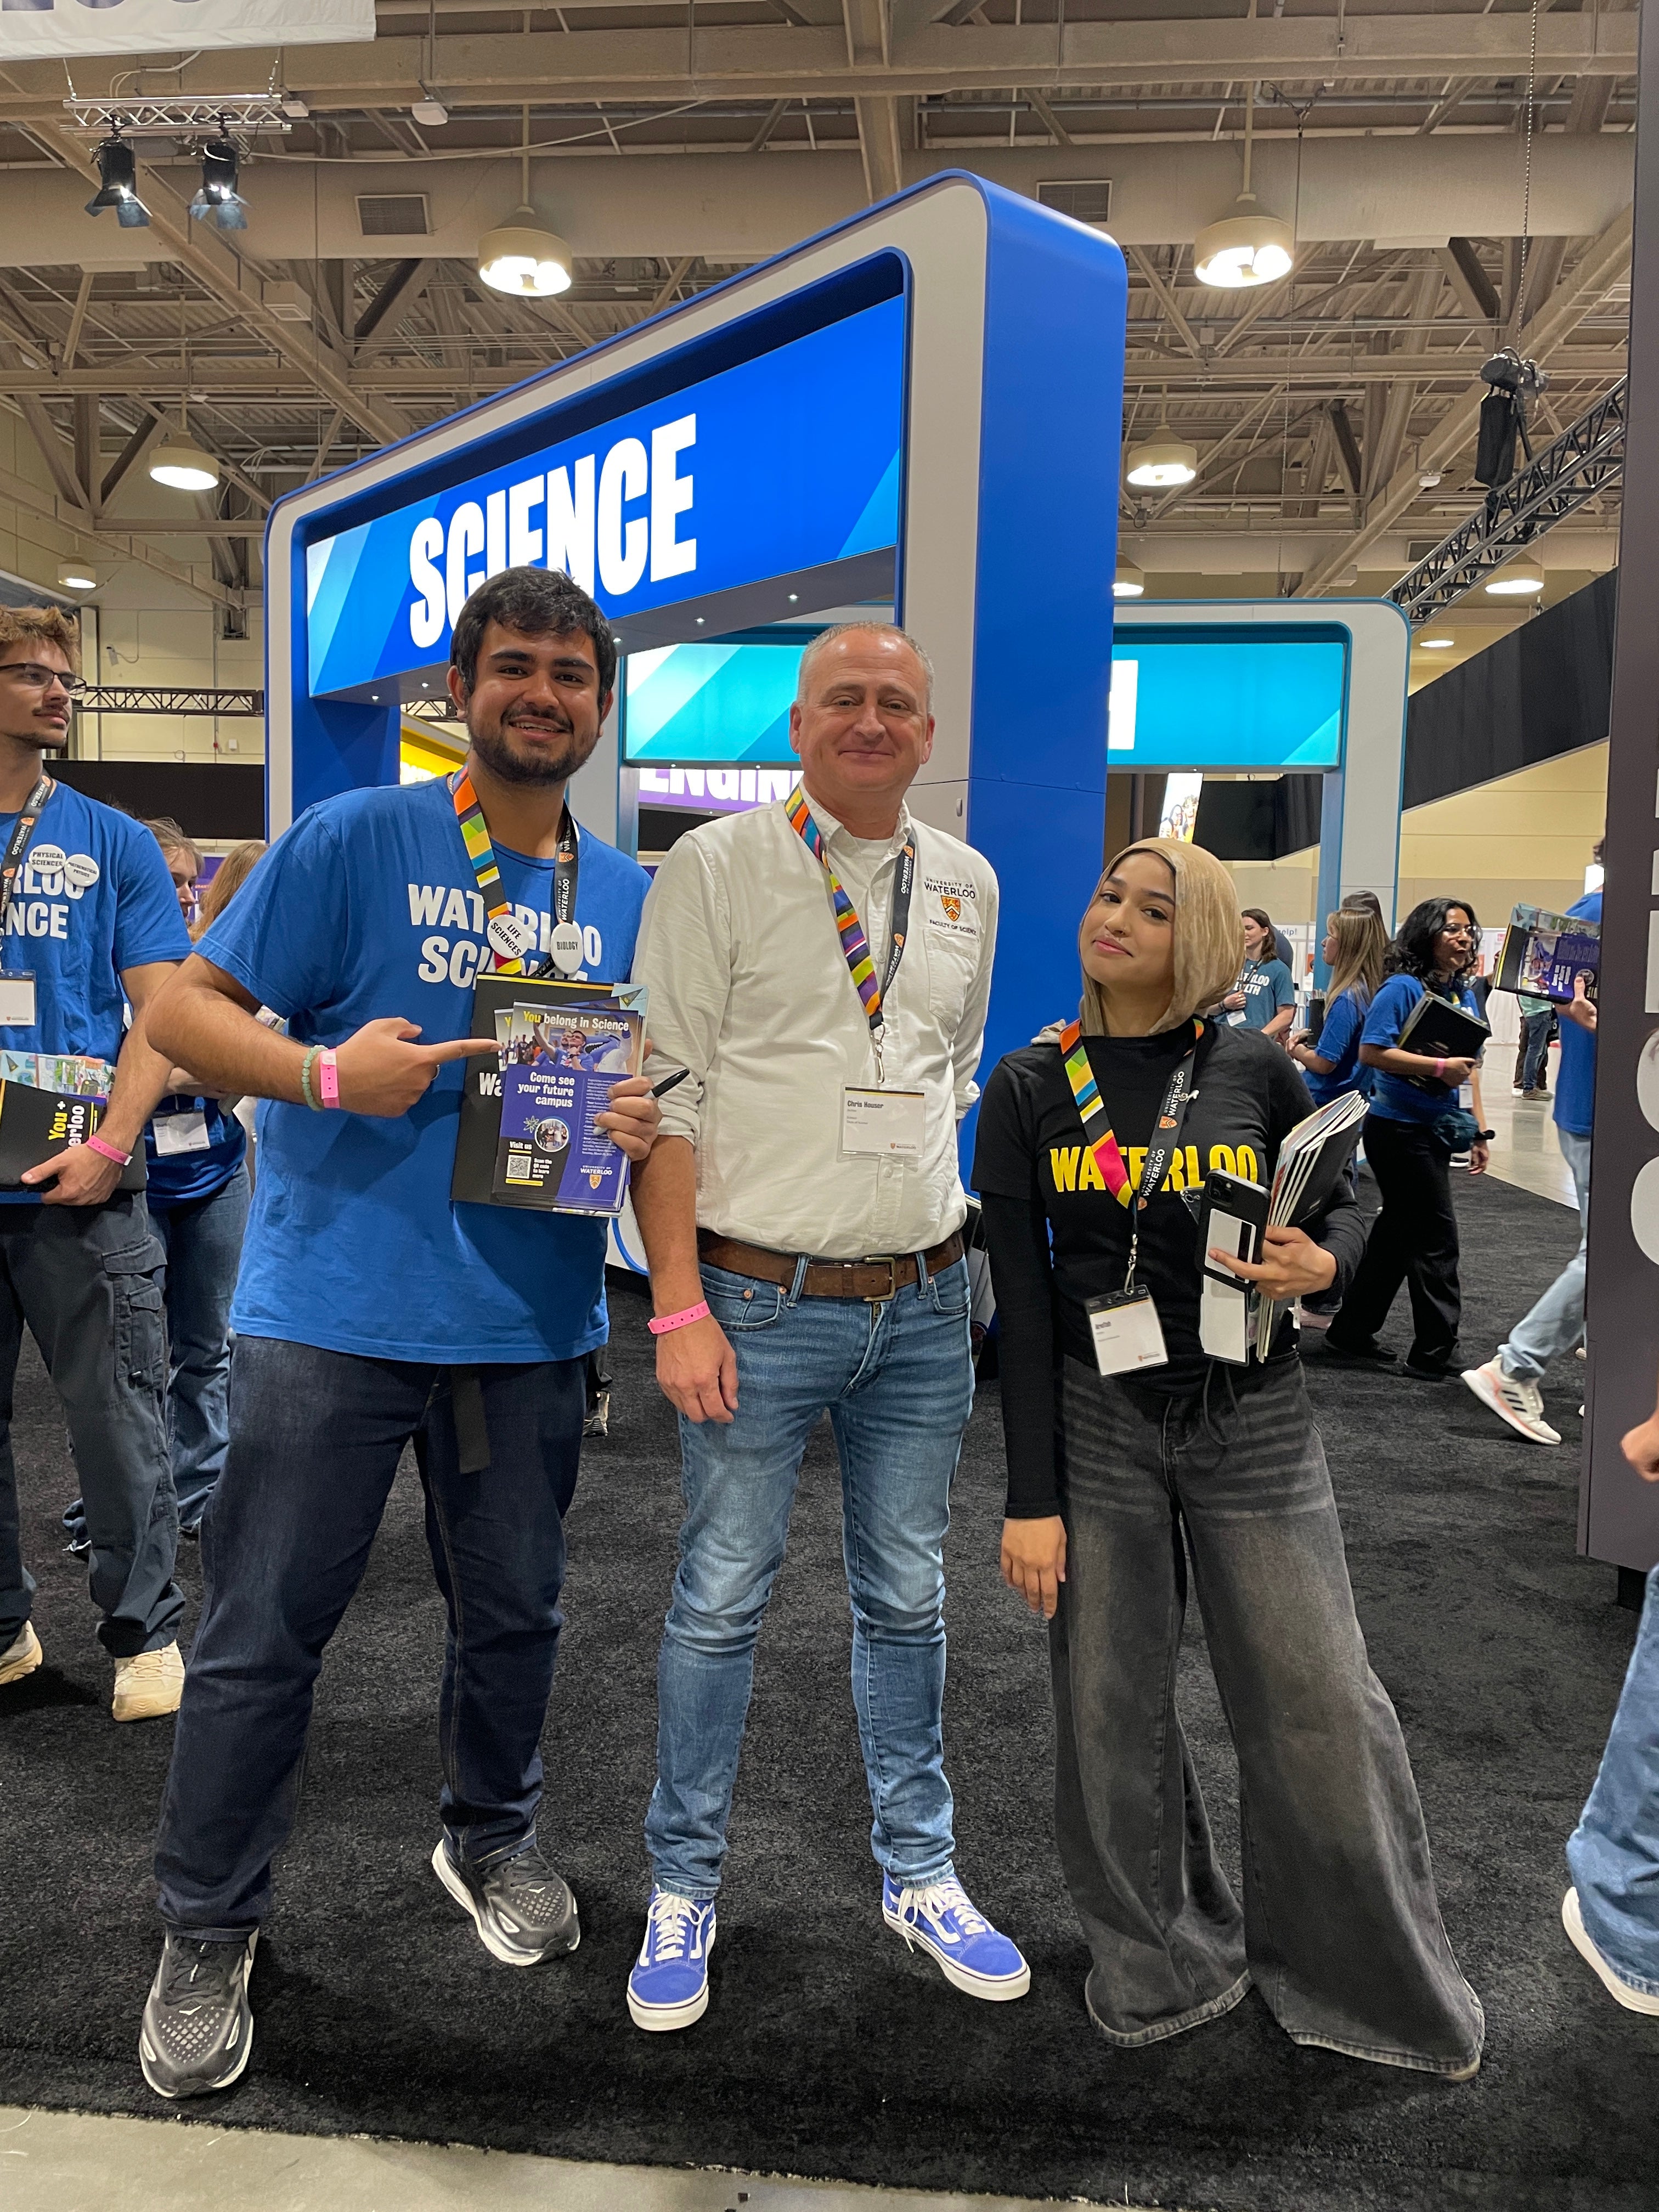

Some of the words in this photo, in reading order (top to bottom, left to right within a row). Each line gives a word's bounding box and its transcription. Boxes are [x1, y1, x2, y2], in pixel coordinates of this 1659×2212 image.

[410, 413, 696, 647] SCIENCE
[12, 825, 27, 855] WATERLOO
[901, 856, 910, 894] WATERLOO
[926, 877, 962, 887] UNIVERSITY
[561, 878, 570, 921] WATERLOO
[924, 882, 975, 899] WATERLOO
[507, 924, 521, 939] LIFE
[929, 919, 949, 928] FACULTY
[491, 922, 522, 956] SCIENCES
[556, 941, 578, 951] BIOLOGY
[523, 1011, 541, 1023] You
[544, 1013, 577, 1029] belong
[580, 1017, 589, 1028] in
[592, 1018, 629, 1031] Science
[530, 1071, 556, 1084] Come
[558, 1076, 575, 1086] see
[517, 1084, 540, 1094] your
[543, 1084, 574, 1097] future
[1168, 1071, 1184, 1116] WATERLOO
[535, 1096, 573, 1108] campus
[48, 1112, 67, 1141] You
[510, 1142, 522, 1150] Visit
[1141, 1159, 1154, 1193] UNIVERSITY
[1151, 1150, 1156, 1159] OF
[1143, 1149, 1165, 1197] WATERLOO
